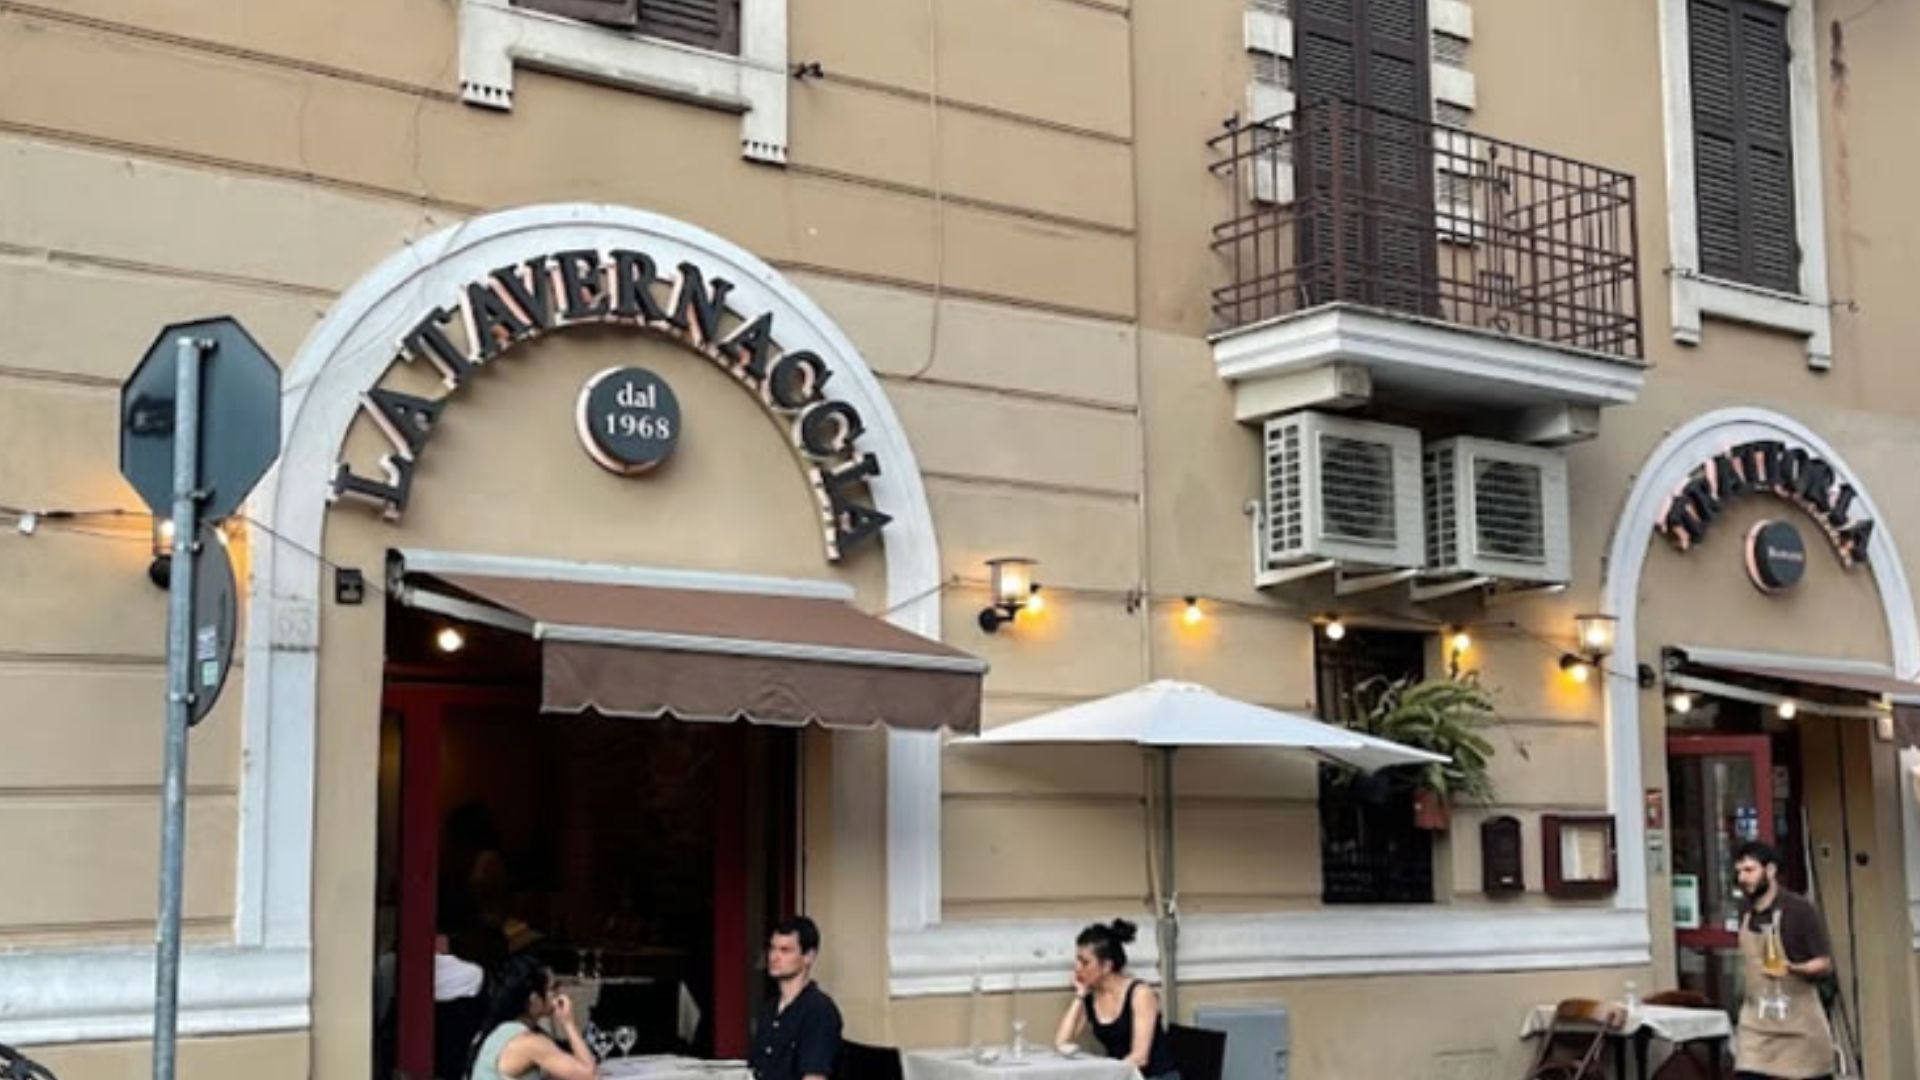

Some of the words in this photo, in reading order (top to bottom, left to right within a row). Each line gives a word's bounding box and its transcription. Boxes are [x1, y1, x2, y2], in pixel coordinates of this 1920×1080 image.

[332, 388, 446, 520] LA
[399, 248, 893, 562] TAVERNACCIA
[606, 413, 670, 440] 1968
[616, 381, 657, 409] dal
[1655, 440, 1874, 570] TRATTORIA
